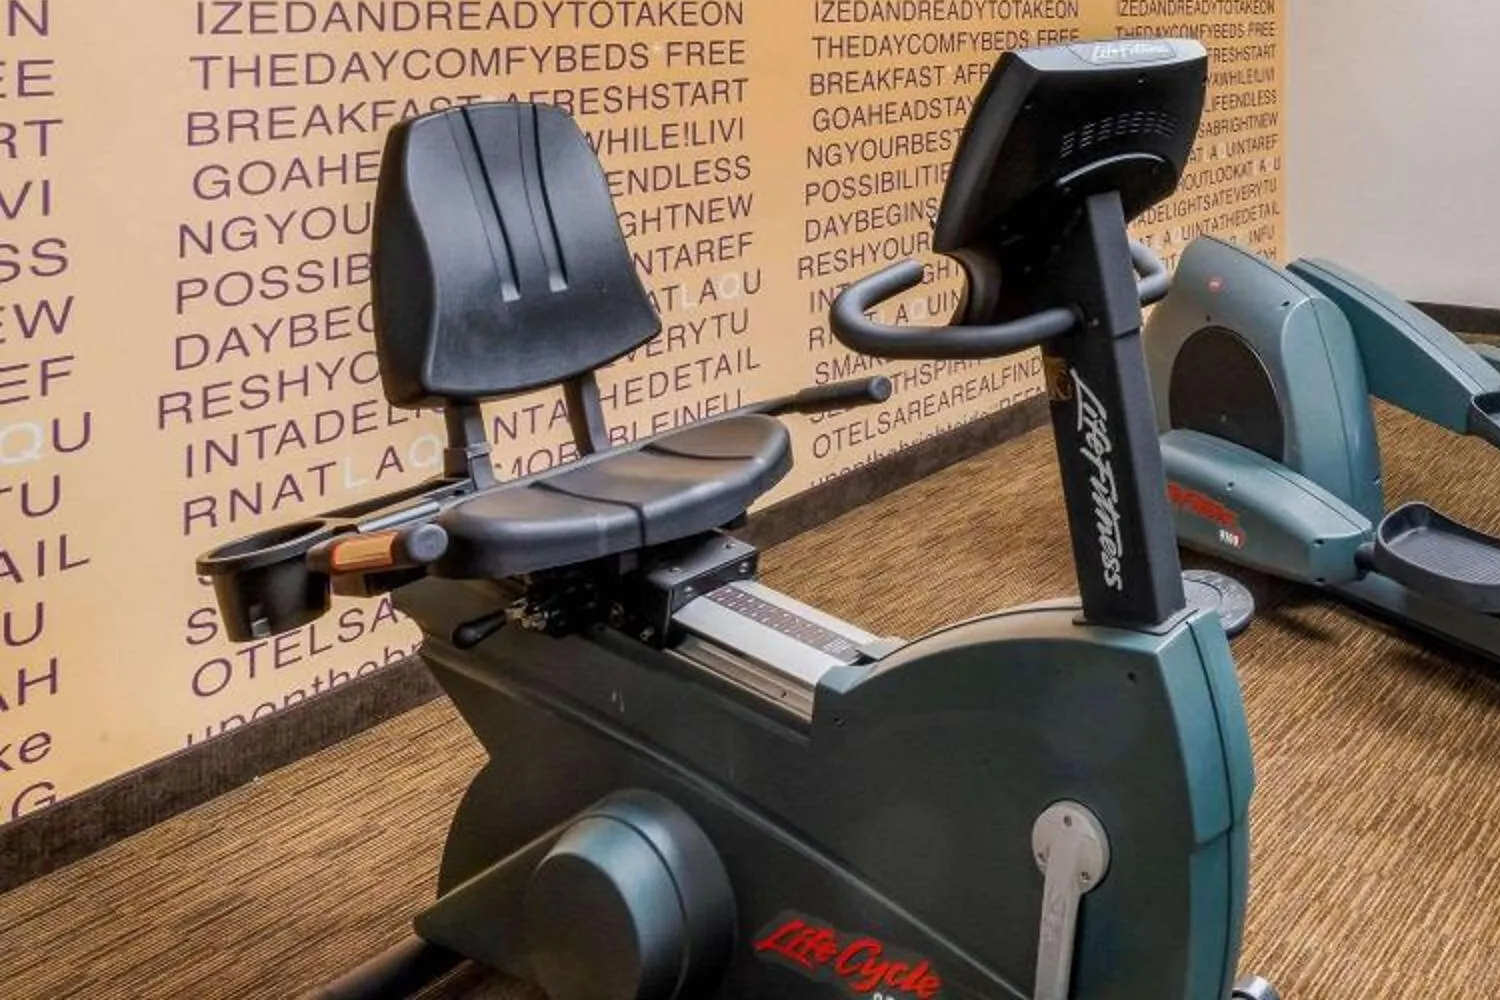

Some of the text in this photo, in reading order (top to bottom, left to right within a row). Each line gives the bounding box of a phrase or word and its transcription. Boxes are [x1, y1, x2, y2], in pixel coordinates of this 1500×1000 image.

[0, 59, 54, 98] E
[0, 295, 74, 343] W
[0, 657, 57, 712] H
